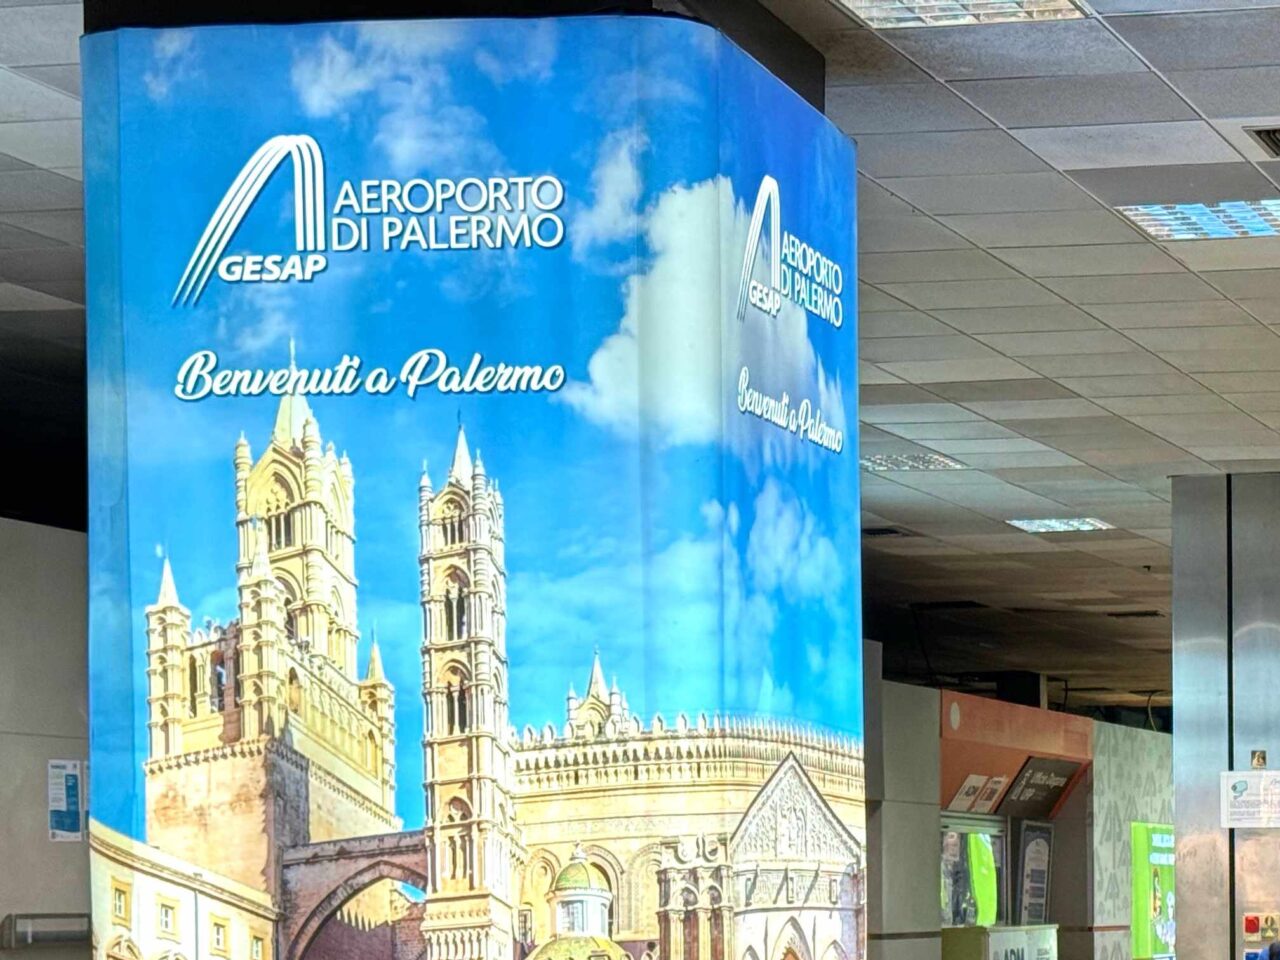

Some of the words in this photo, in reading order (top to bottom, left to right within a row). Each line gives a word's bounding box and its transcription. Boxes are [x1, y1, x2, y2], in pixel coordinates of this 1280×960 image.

[333, 176, 563, 214] AEROPORTO
[332, 217, 367, 251] DI
[383, 212, 564, 251] PALERMO
[218, 254, 327, 282] GESAP
[781, 231, 842, 296] AEROPORTO
[748, 279, 781, 317] GESAP
[781, 263, 794, 299] DI
[794, 273, 842, 328] PALERMO
[174, 350, 363, 400] Benvenuti
[364, 366, 395, 394] a
[400, 348, 565, 399] Palermo
[737, 366, 789, 431] Benvenuti
[789, 413, 797, 433] a
[797, 398, 843, 453] Palermo
